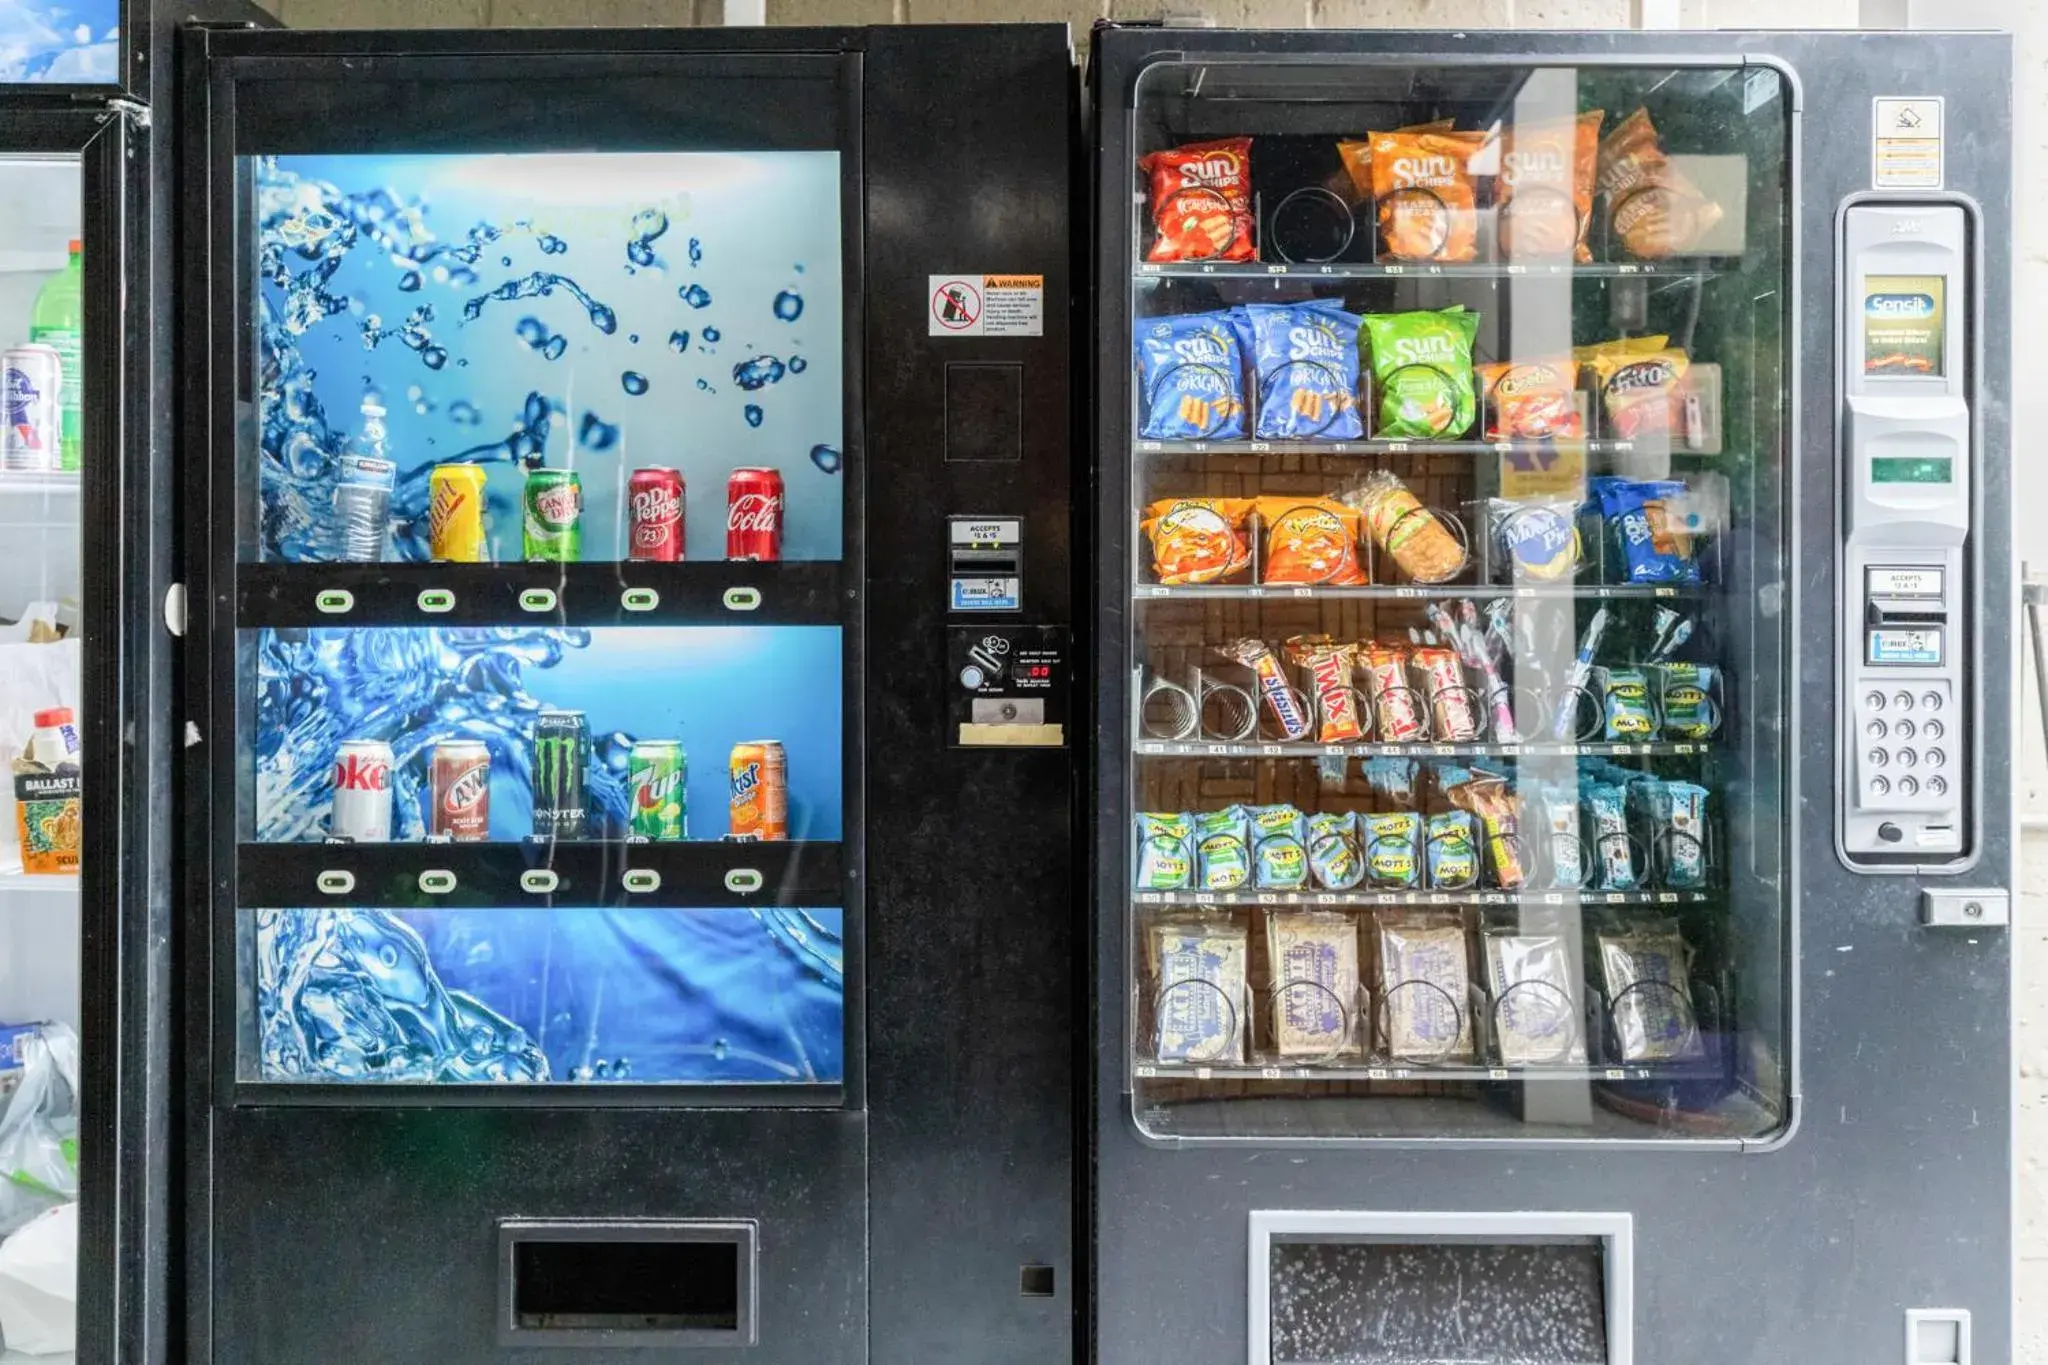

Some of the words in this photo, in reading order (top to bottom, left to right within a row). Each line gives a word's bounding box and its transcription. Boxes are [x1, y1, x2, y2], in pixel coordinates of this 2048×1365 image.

[1180, 160, 1240, 187] Sun
[1393, 156, 1456, 189] Sun
[999, 280, 1040, 288] WARNING
[1174, 338, 1228, 364] Sun
[1288, 327, 1344, 359] Sun
[1395, 336, 1456, 366] Sun
[651, 487, 672, 503] Dr
[727, 494, 779, 532] Cola
[1314, 653, 1350, 720] TWIX
[25, 778, 74, 791] BALLAST
